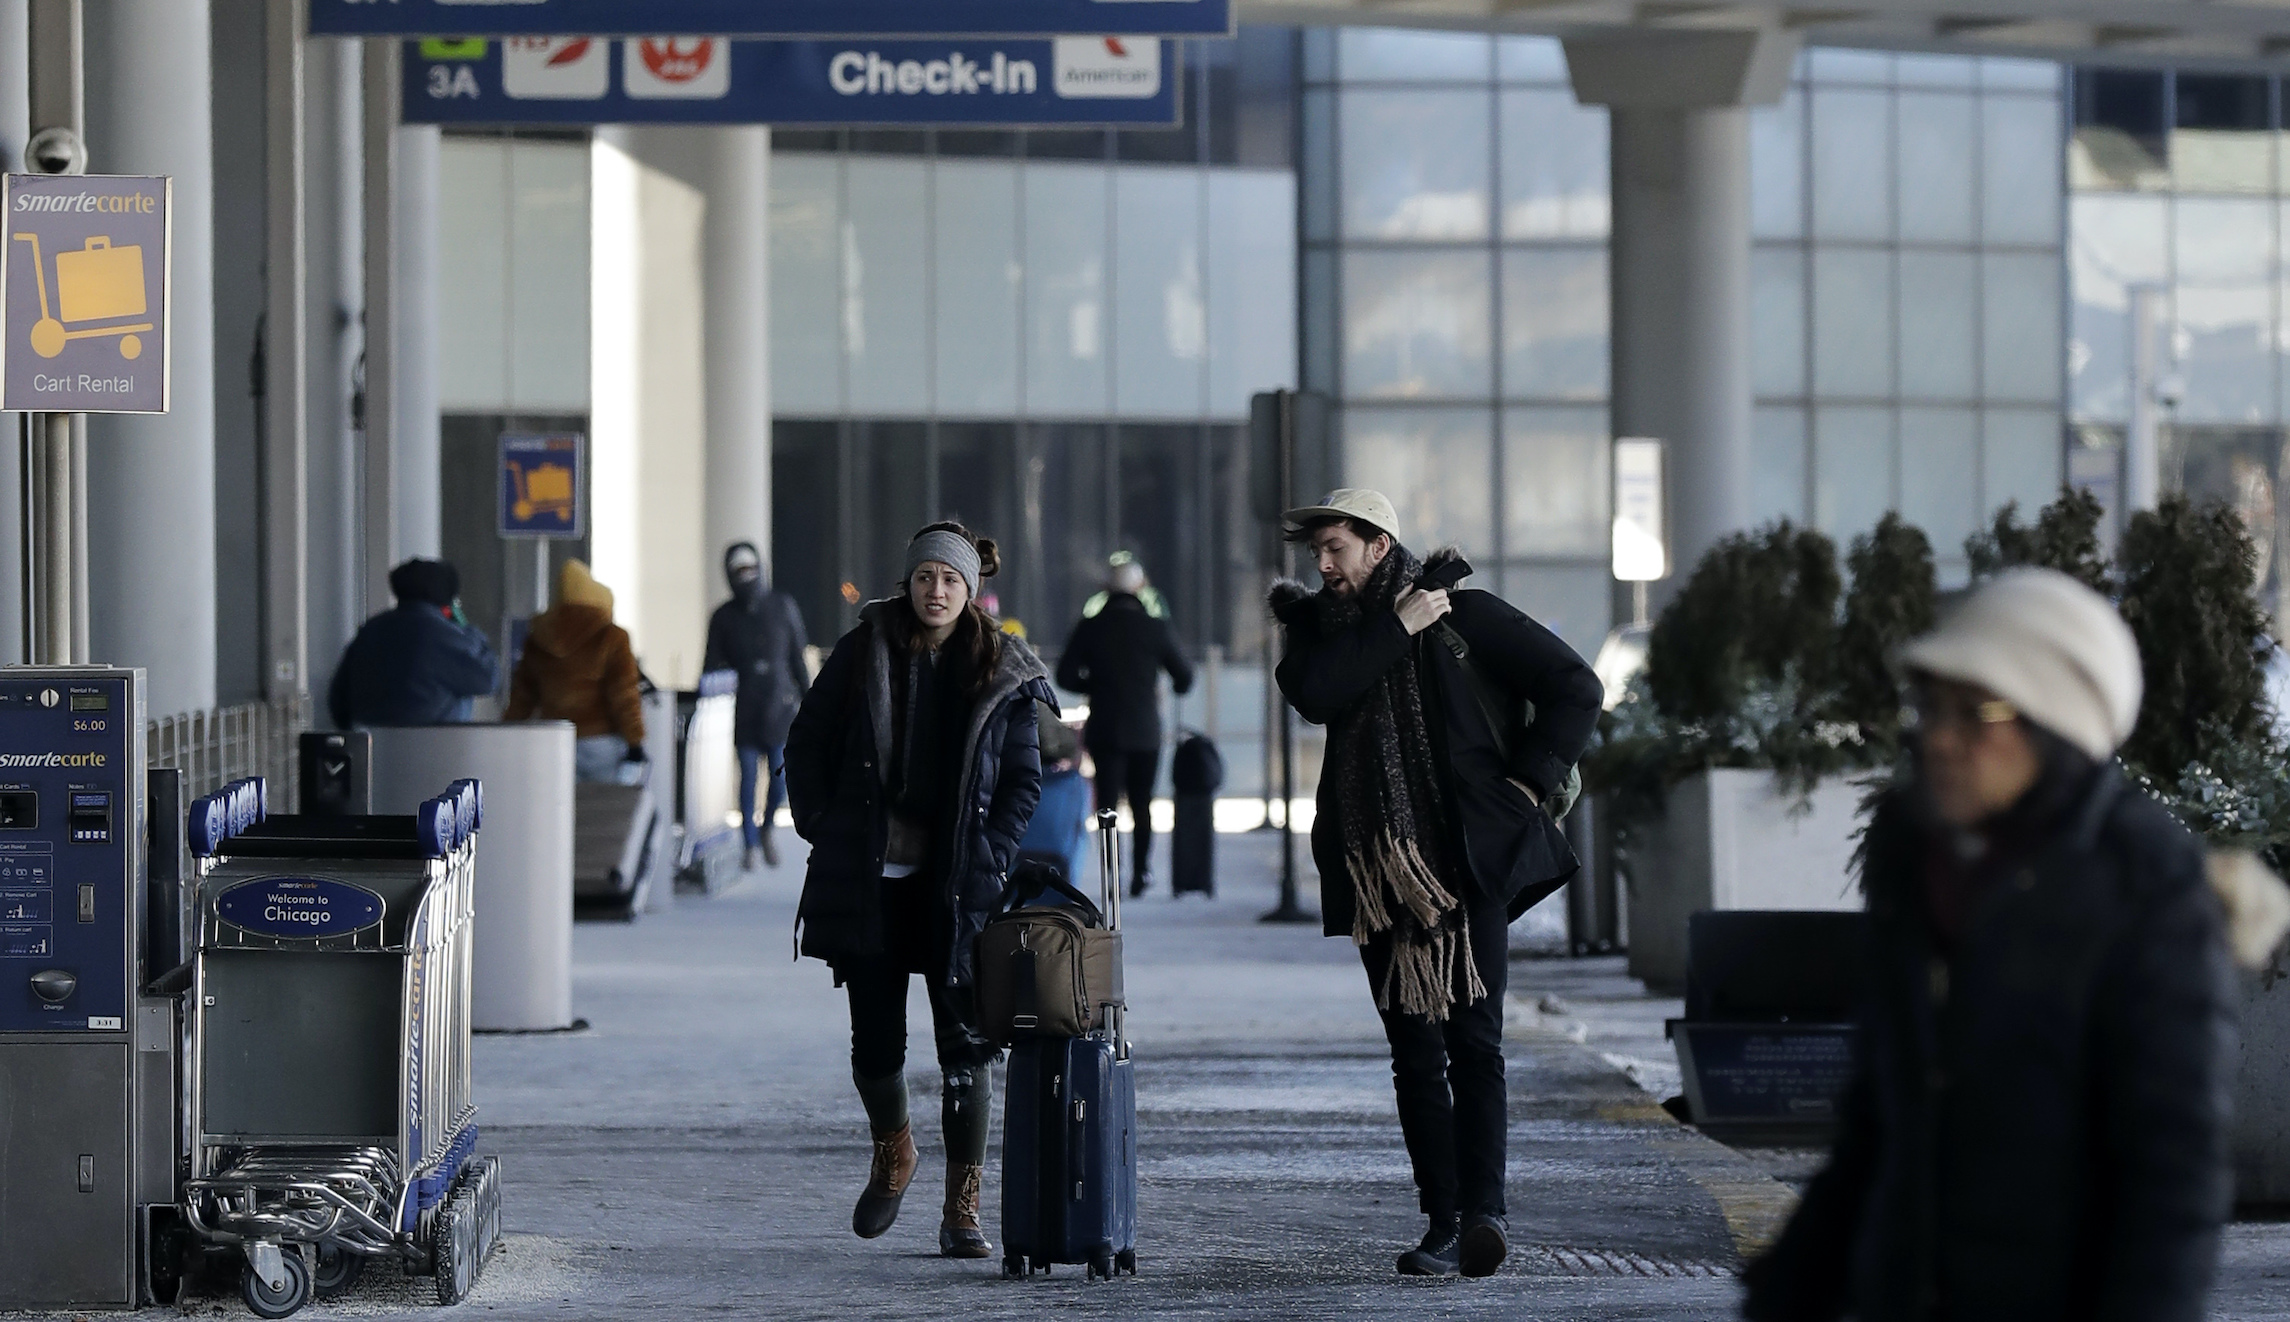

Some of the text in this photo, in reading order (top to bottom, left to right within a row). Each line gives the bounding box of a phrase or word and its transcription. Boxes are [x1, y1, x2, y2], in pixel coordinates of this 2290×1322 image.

[427, 65, 480, 98] 3A
[829, 51, 1037, 94] Check-In
[33, 374, 134, 393] Cart Rental
[73, 720, 106, 731] $6.00
[267, 894, 329, 905] Welcome to
[264, 906, 331, 926] Chicago
